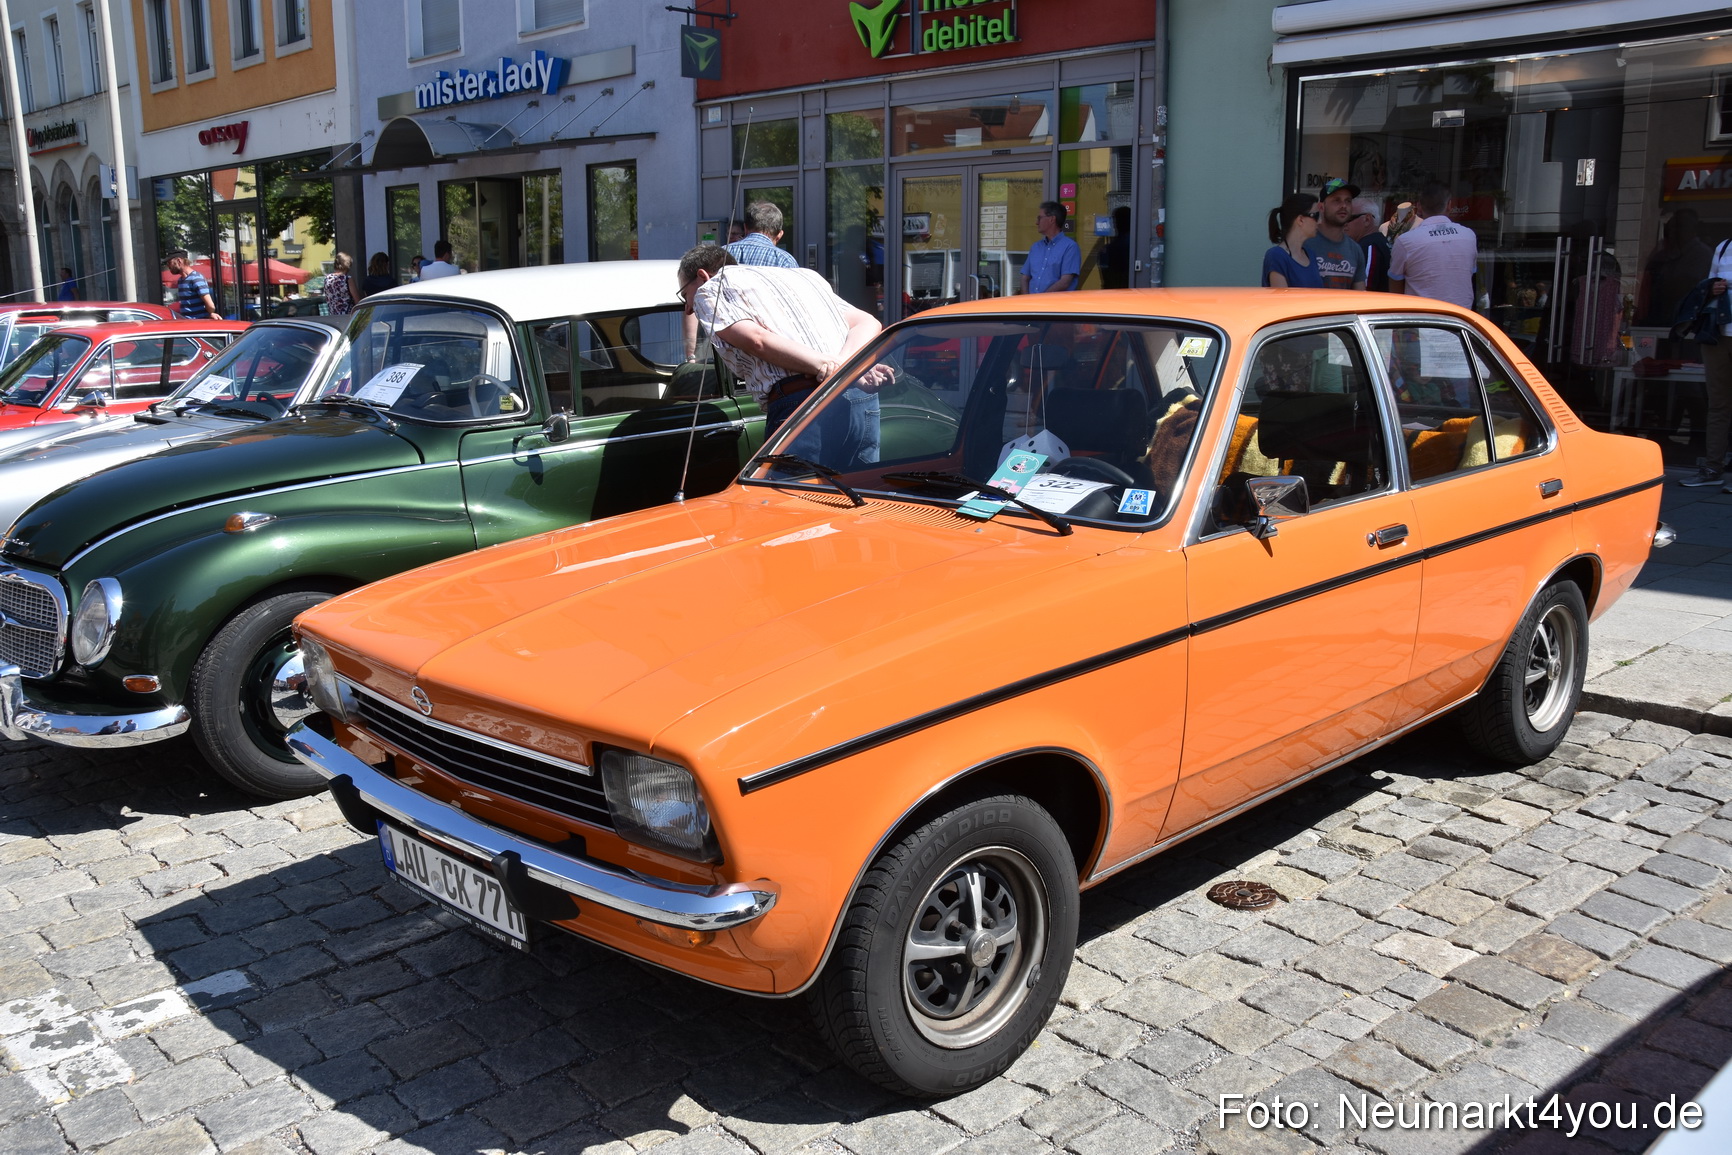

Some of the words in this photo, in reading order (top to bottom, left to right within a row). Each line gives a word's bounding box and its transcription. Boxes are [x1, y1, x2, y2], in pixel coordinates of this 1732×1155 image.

[923, 8, 1015, 52] debitel
[415, 70, 488, 109] mister
[498, 50, 556, 95] lady
[198, 120, 249, 155] orsay
[386, 371, 407, 384] 388
[1039, 479, 1084, 490] 322
[388, 830, 430, 887] LAU
[441, 858, 472, 910] CK
[884, 831, 949, 930] DAYTON
[957, 808, 1013, 837] D100
[511, 938, 522, 950] ATB
